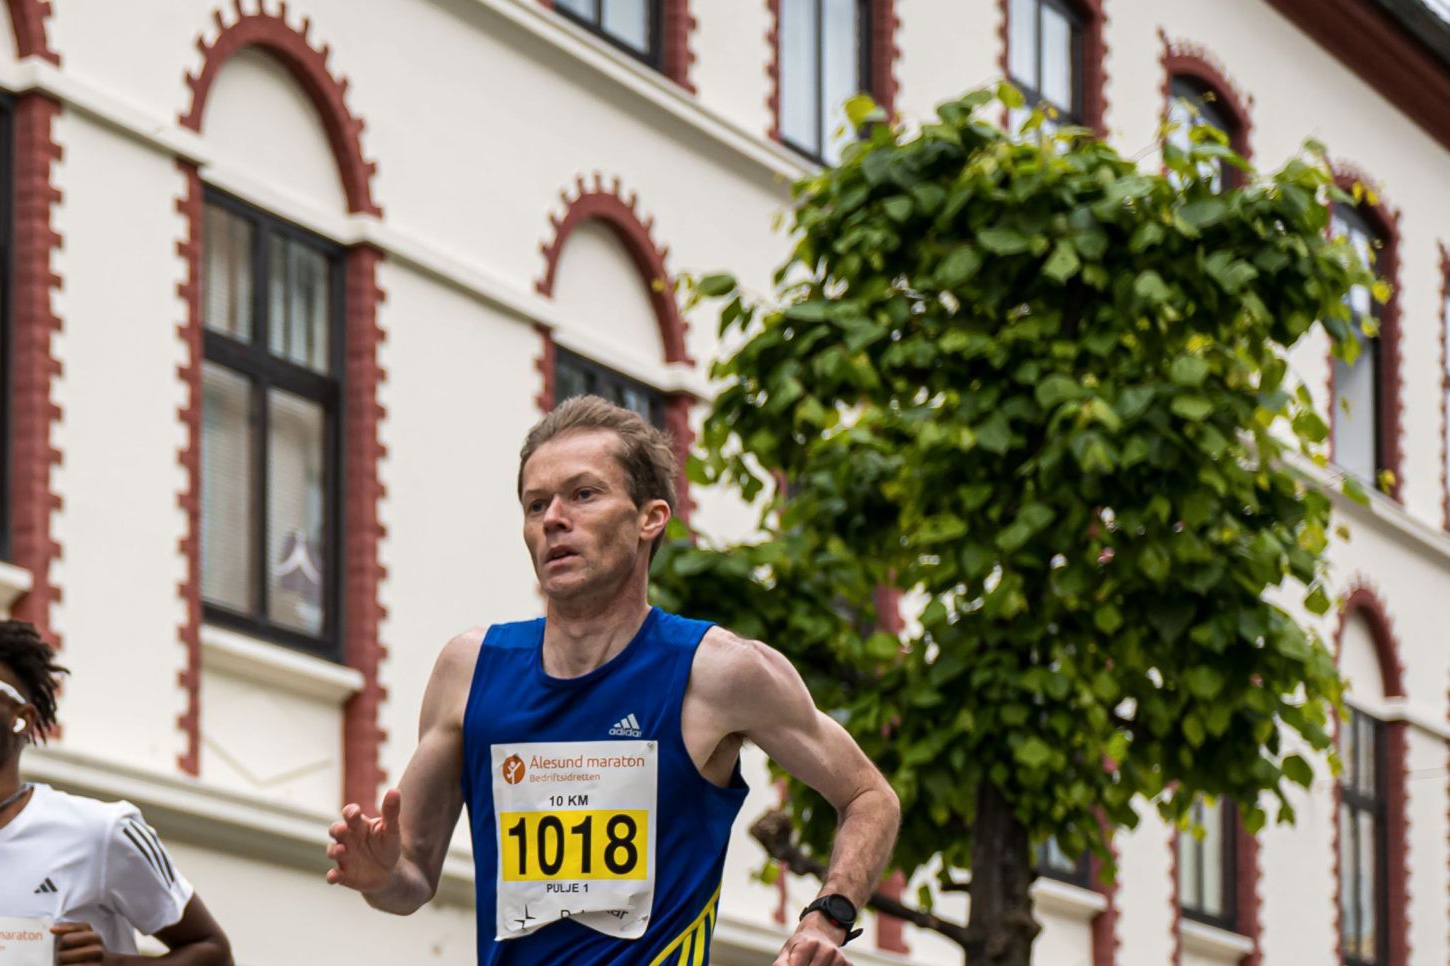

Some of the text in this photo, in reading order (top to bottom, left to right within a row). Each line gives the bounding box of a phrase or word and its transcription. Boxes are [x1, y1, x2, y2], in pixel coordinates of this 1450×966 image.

[587, 756, 645, 768] maraton
[549, 795, 588, 807] 10 KM
[508, 814, 638, 875] 1018
[546, 883, 589, 893] PULJE 1
